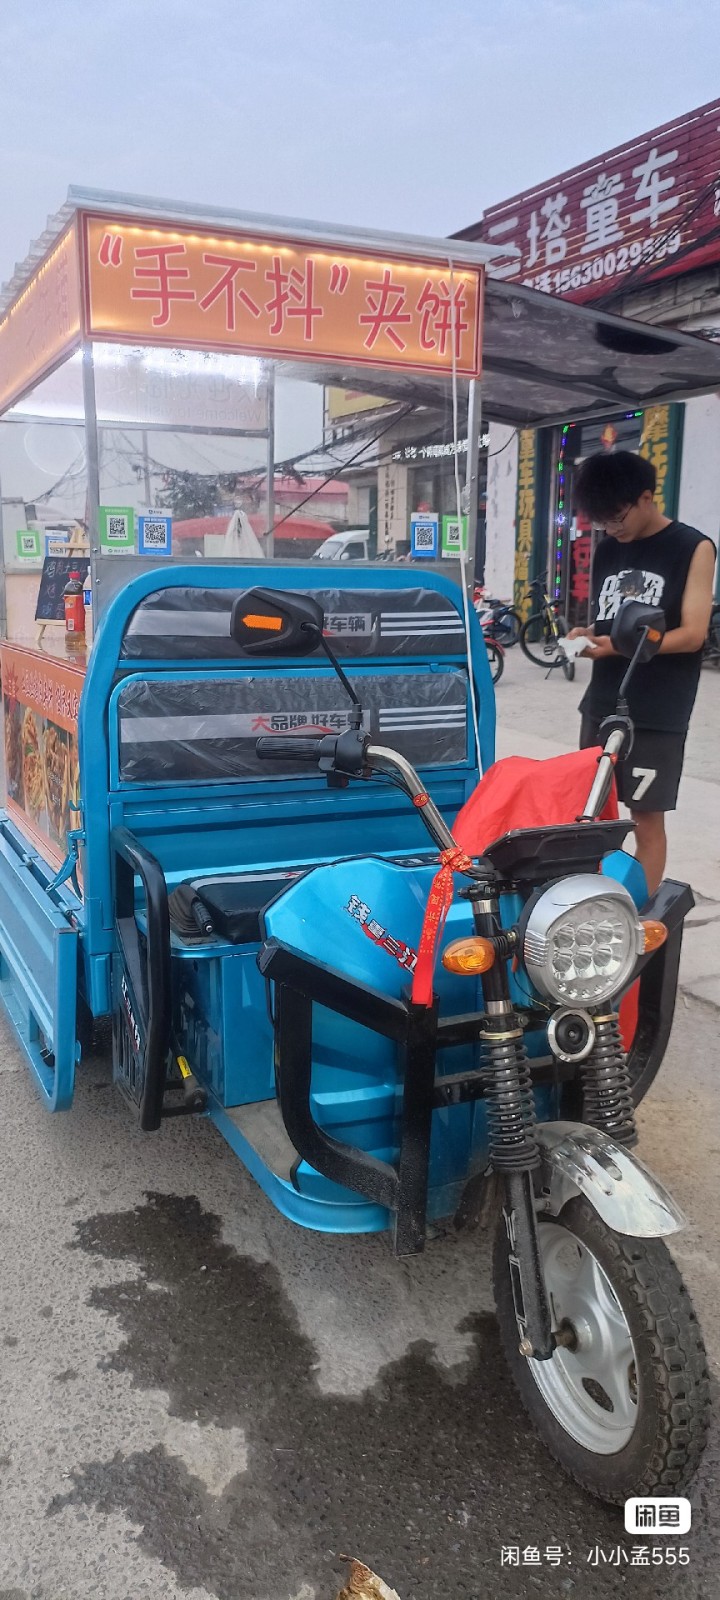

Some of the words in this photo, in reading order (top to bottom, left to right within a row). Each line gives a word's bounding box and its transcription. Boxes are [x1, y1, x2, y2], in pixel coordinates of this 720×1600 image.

[487, 147, 681, 278] 三塔童车
[251, 714, 308, 733] 大品牌
[632, 767, 657, 801] 7
